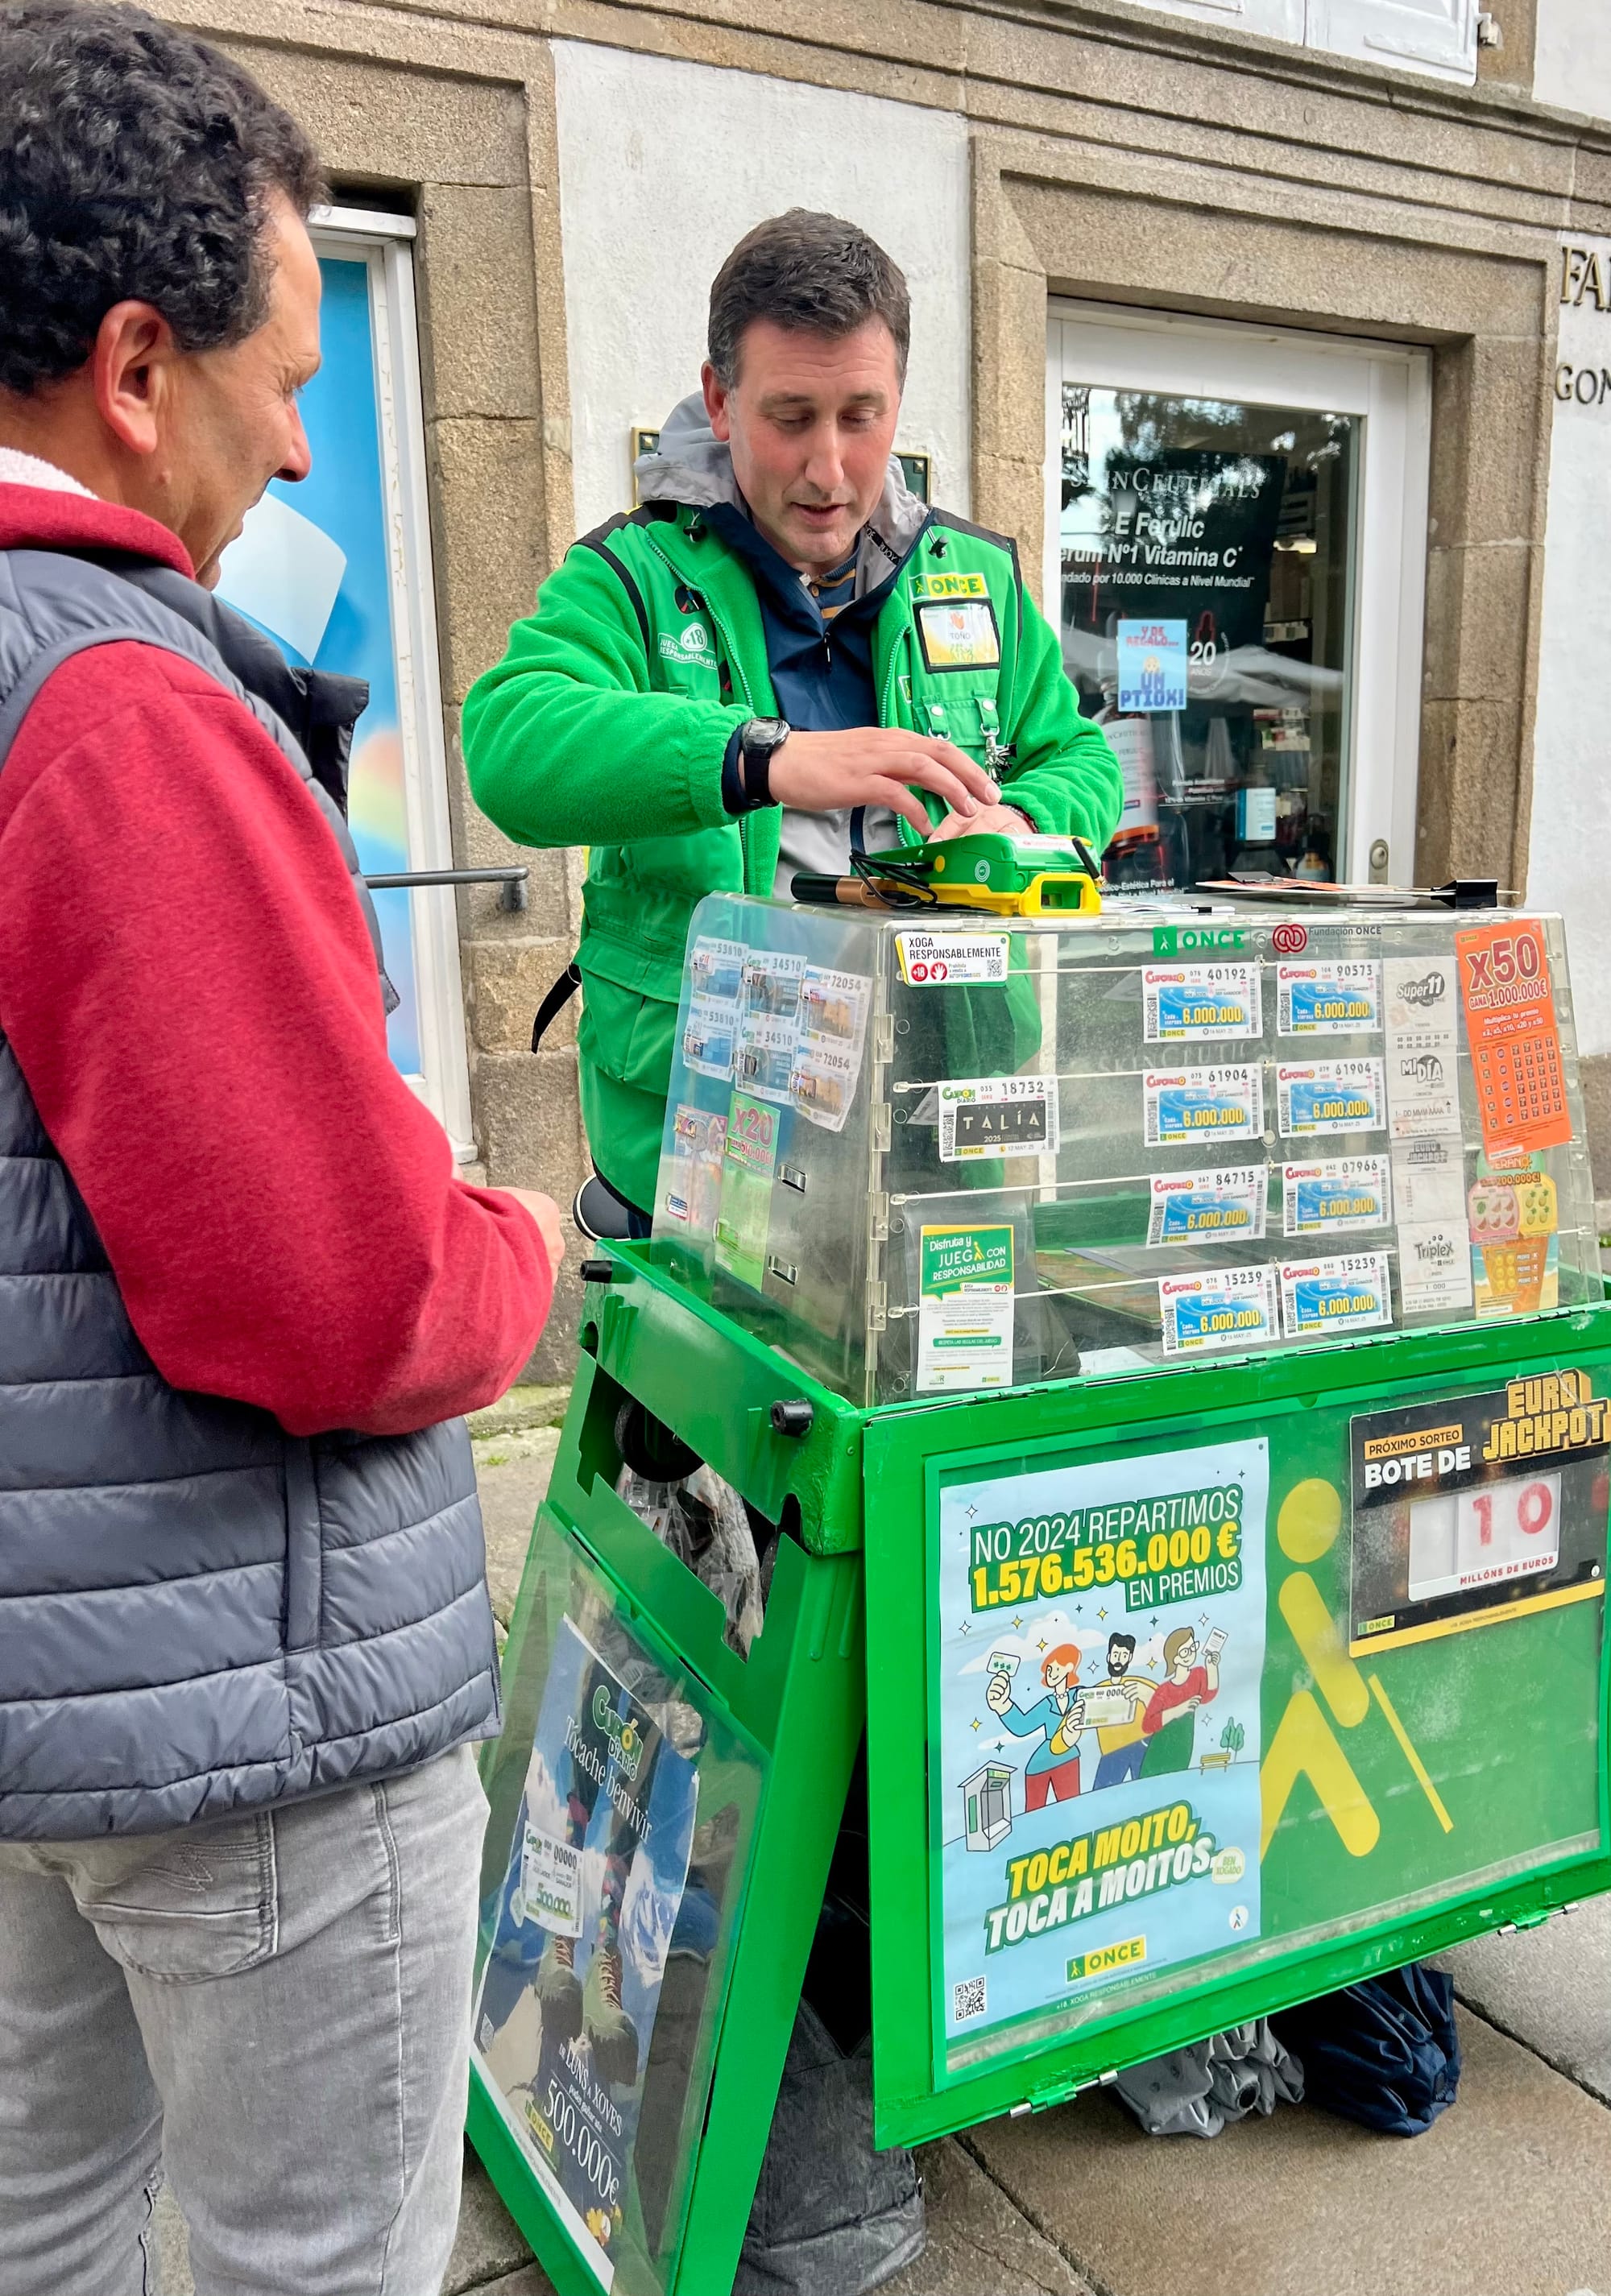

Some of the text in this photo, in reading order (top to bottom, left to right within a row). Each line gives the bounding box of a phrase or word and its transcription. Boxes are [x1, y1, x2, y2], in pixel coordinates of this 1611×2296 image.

[1560, 246, 1611, 312] FA
[1135, 512, 1205, 539] Ferulic
[1145, 545, 1218, 568] Vitamina
[1092, 574, 1110, 586] por
[1112, 573, 1142, 585] 10.000
[1190, 573, 1213, 587] Nivel
[1190, 641, 1216, 666] 20
[1141, 672, 1165, 690] UN
[1182, 929, 1245, 949] ONCE
[1356, 926, 1381, 935] ONCE
[716, 943, 742, 957] 53810
[909, 937, 934, 948] XOGA
[909, 947, 1001, 960] RESPONSABLEMENTE
[773, 958, 801, 971] 34510
[1208, 968, 1246, 980] 40192
[1337, 965, 1373, 977] 90573
[831, 975, 862, 991] 72054
[1470, 979, 1547, 1007] GANA 1.000.000€
[765, 1032, 793, 1045] 34510
[824, 1053, 851, 1070] 72054
[1336, 1062, 1371, 1075] 61904
[1209, 1069, 1248, 1082] 61904
[1002, 1081, 1044, 1095] 18732
[963, 1111, 1040, 1131] TALÍA
[984, 1135, 1001, 1143] 2025
[963, 1147, 984, 1155] ONCE
[1342, 1160, 1377, 1173] 07966
[1215, 1171, 1254, 1185] 84715
[930, 1235, 971, 1252] Disfruta y
[986, 1246, 1006, 1258] CON
[933, 1259, 1006, 1281] RESPONSABILIDAD
[1340, 1257, 1376, 1272] 15239
[1224, 1271, 1262, 1286] 15239
[1508, 1371, 1579, 1419] EURO
[1369, 1429, 1460, 1456] PRÓXIMO SORTEO
[1483, 1404, 1606, 1462] JACKPOT
[1365, 1445, 1472, 1489] BOTE DE
[975, 1488, 1240, 1565] NO 2024 REPARTIMOS
[973, 1520, 1239, 1607] 1.576.536.000 €
[1460, 1555, 1555, 1586] MILLÓNS DE EUROS
[1129, 1561, 1239, 1607] EN PREMIOS
[1368, 1618, 1394, 1631] ONCE
[564, 1714, 652, 1844] Tócache benvivir
[1010, 1805, 1197, 1900] TOCA MOITO,
[988, 1886, 1067, 1950] TOCA
[1071, 1876, 1093, 1919] A
[1089, 1940, 1141, 1970] ONCE
[1070, 1992, 1089, 2004] XOGA
[1090, 1971, 1158, 1998] RESPONSABLEMENTE
[565, 2046, 589, 2091] LUNS
[592, 2082, 623, 2137] XOVES
[532, 2112, 552, 2146] ONCE
[544, 2079, 619, 2205] 500.000€
